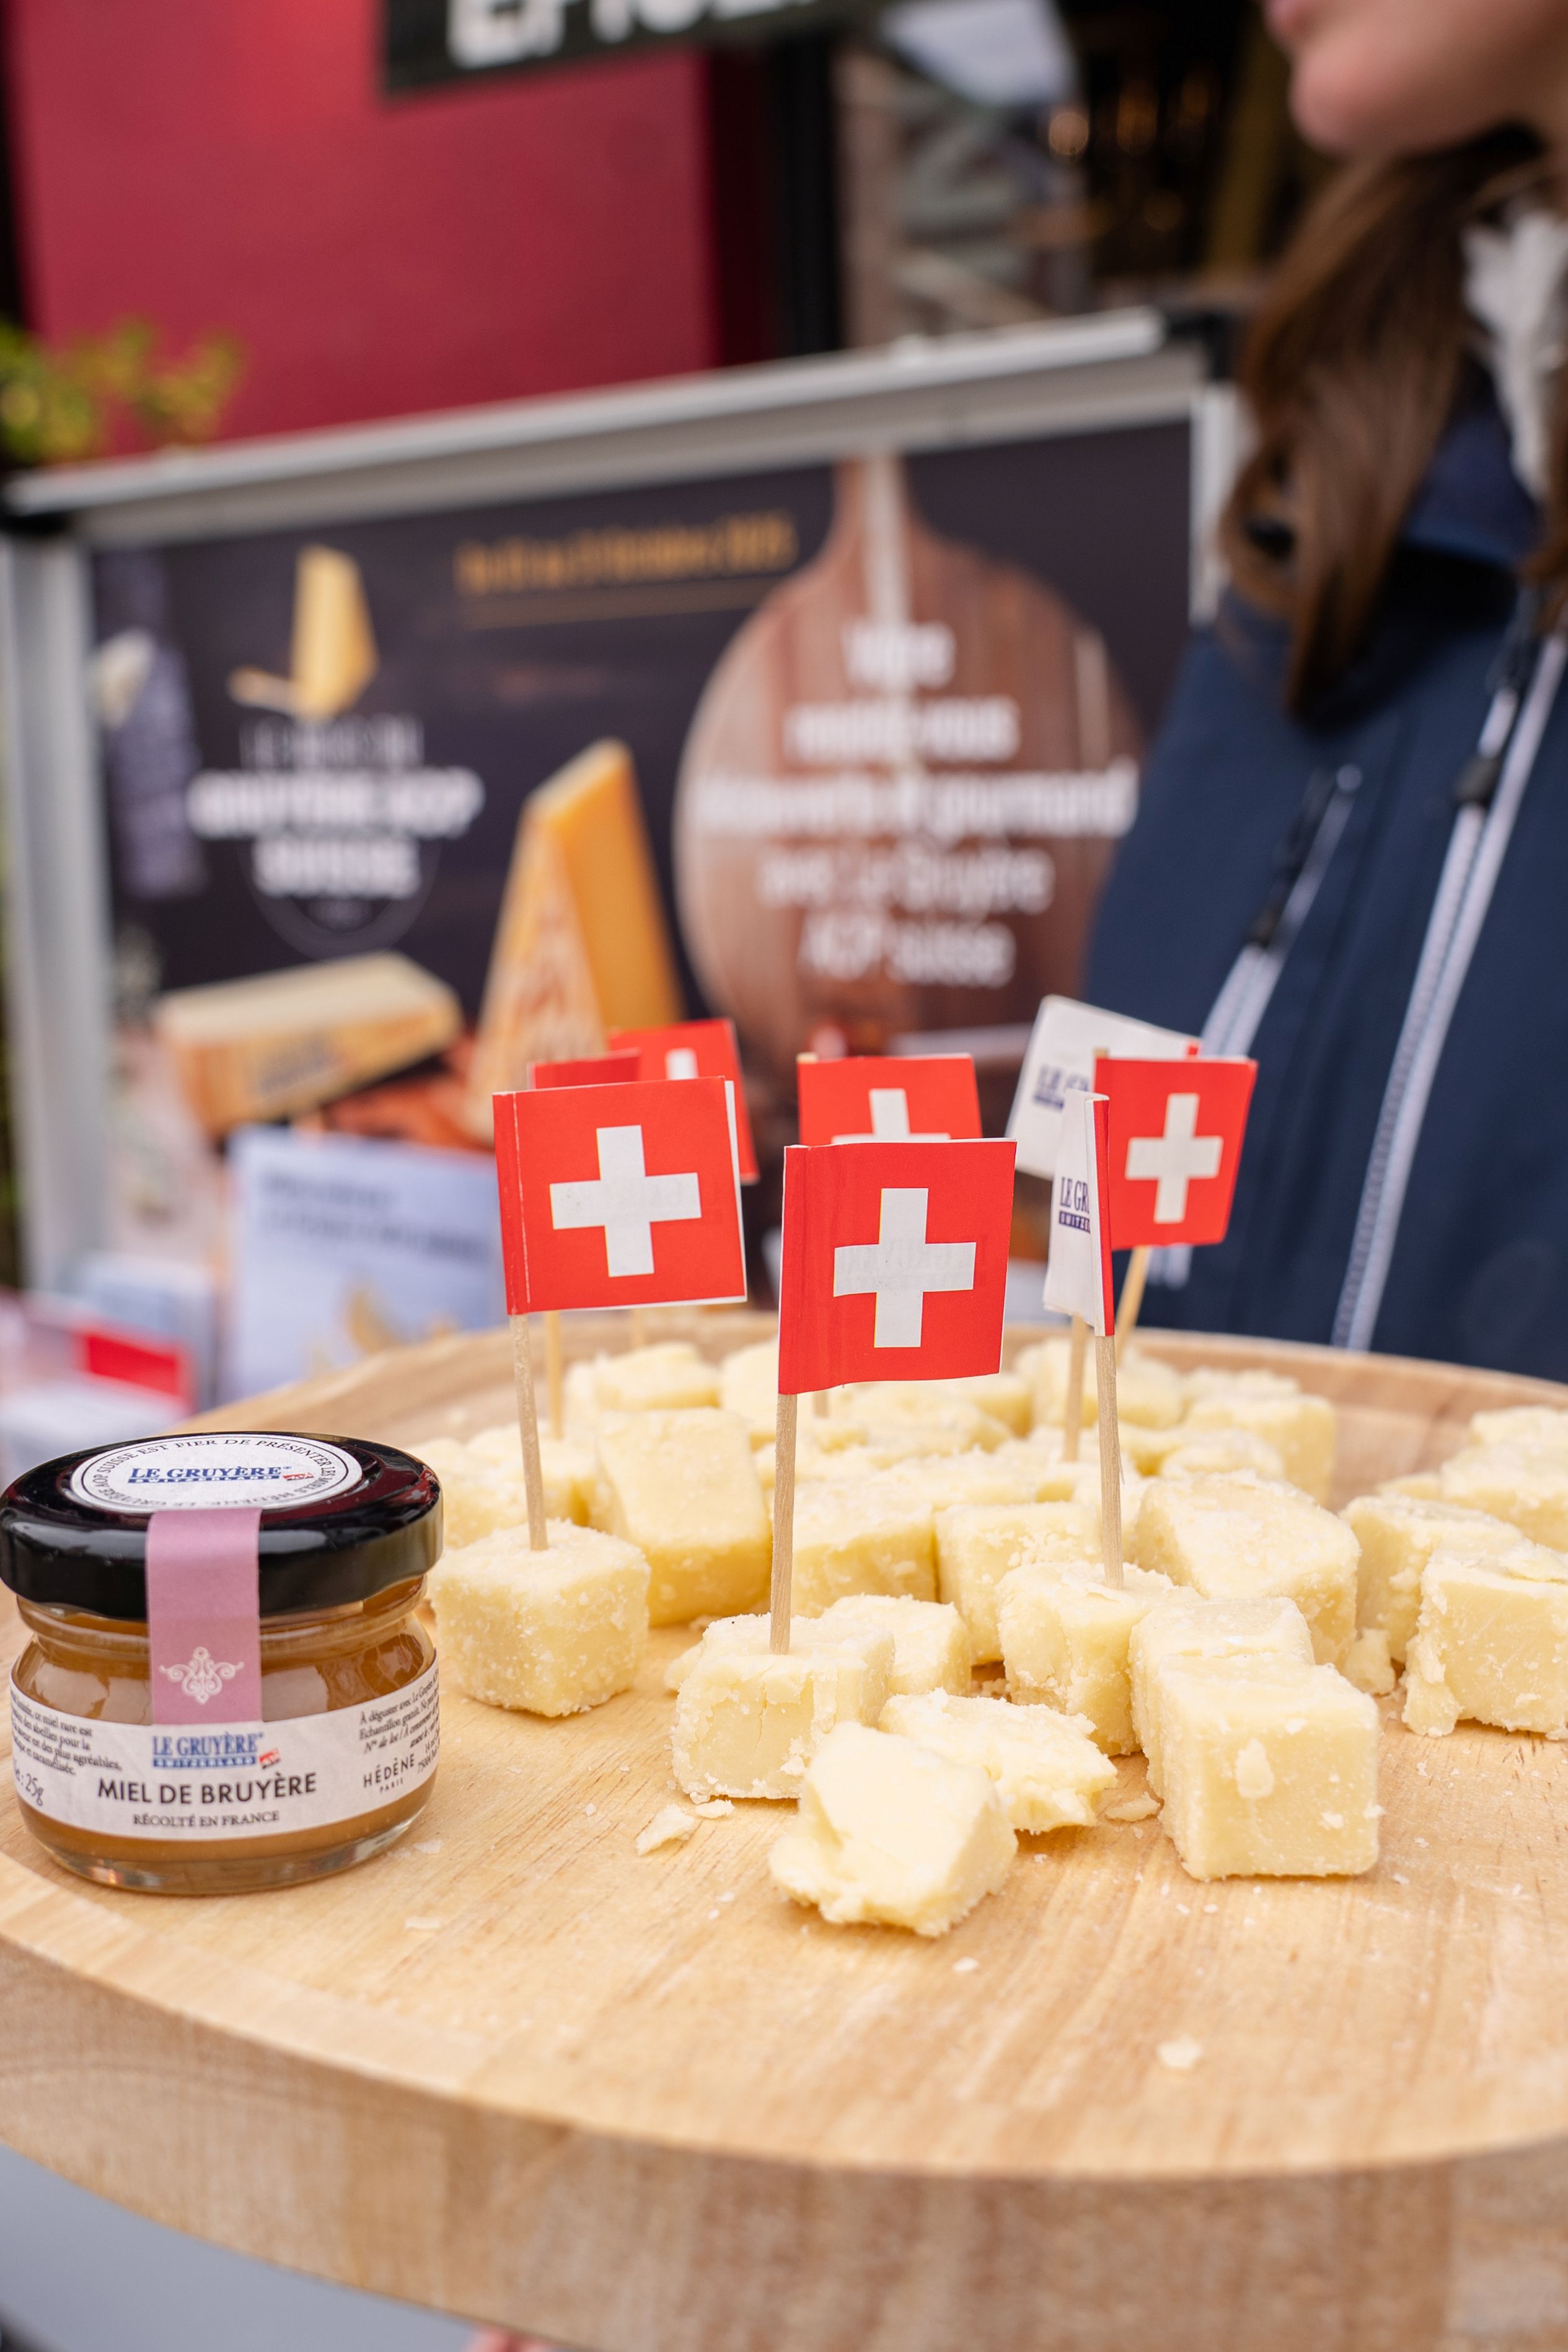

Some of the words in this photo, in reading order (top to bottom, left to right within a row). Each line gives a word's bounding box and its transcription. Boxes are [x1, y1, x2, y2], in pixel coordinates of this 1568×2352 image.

[1060, 1176, 1072, 1207] LE
[137, 1444, 169, 1455] EST
[174, 1439, 218, 1448] FIER
[255, 1440, 333, 1467] PRÉSENTER
[97, 1452, 139, 1474] SUISSE
[130, 1468, 161, 1478] LE
[320, 1466, 337, 1477] LES
[93, 1474, 110, 1488] AOP
[43, 1715, 59, 1727] miel
[59, 1736, 81, 1750] pour
[152, 1735, 173, 1756] LE
[54, 1748, 72, 1762] plus
[25, 1773, 44, 1806] 25g
[98, 1777, 152, 1804] MIEL
[159, 1783, 192, 1805] DE
[201, 1771, 317, 1804] BRUYÈRE
[379, 1777, 404, 1793] PARIS
[133, 1812, 195, 1828] RÉCOLTÉ
[198, 1813, 218, 1827] EN
[221, 1810, 280, 1826] FRANCE
